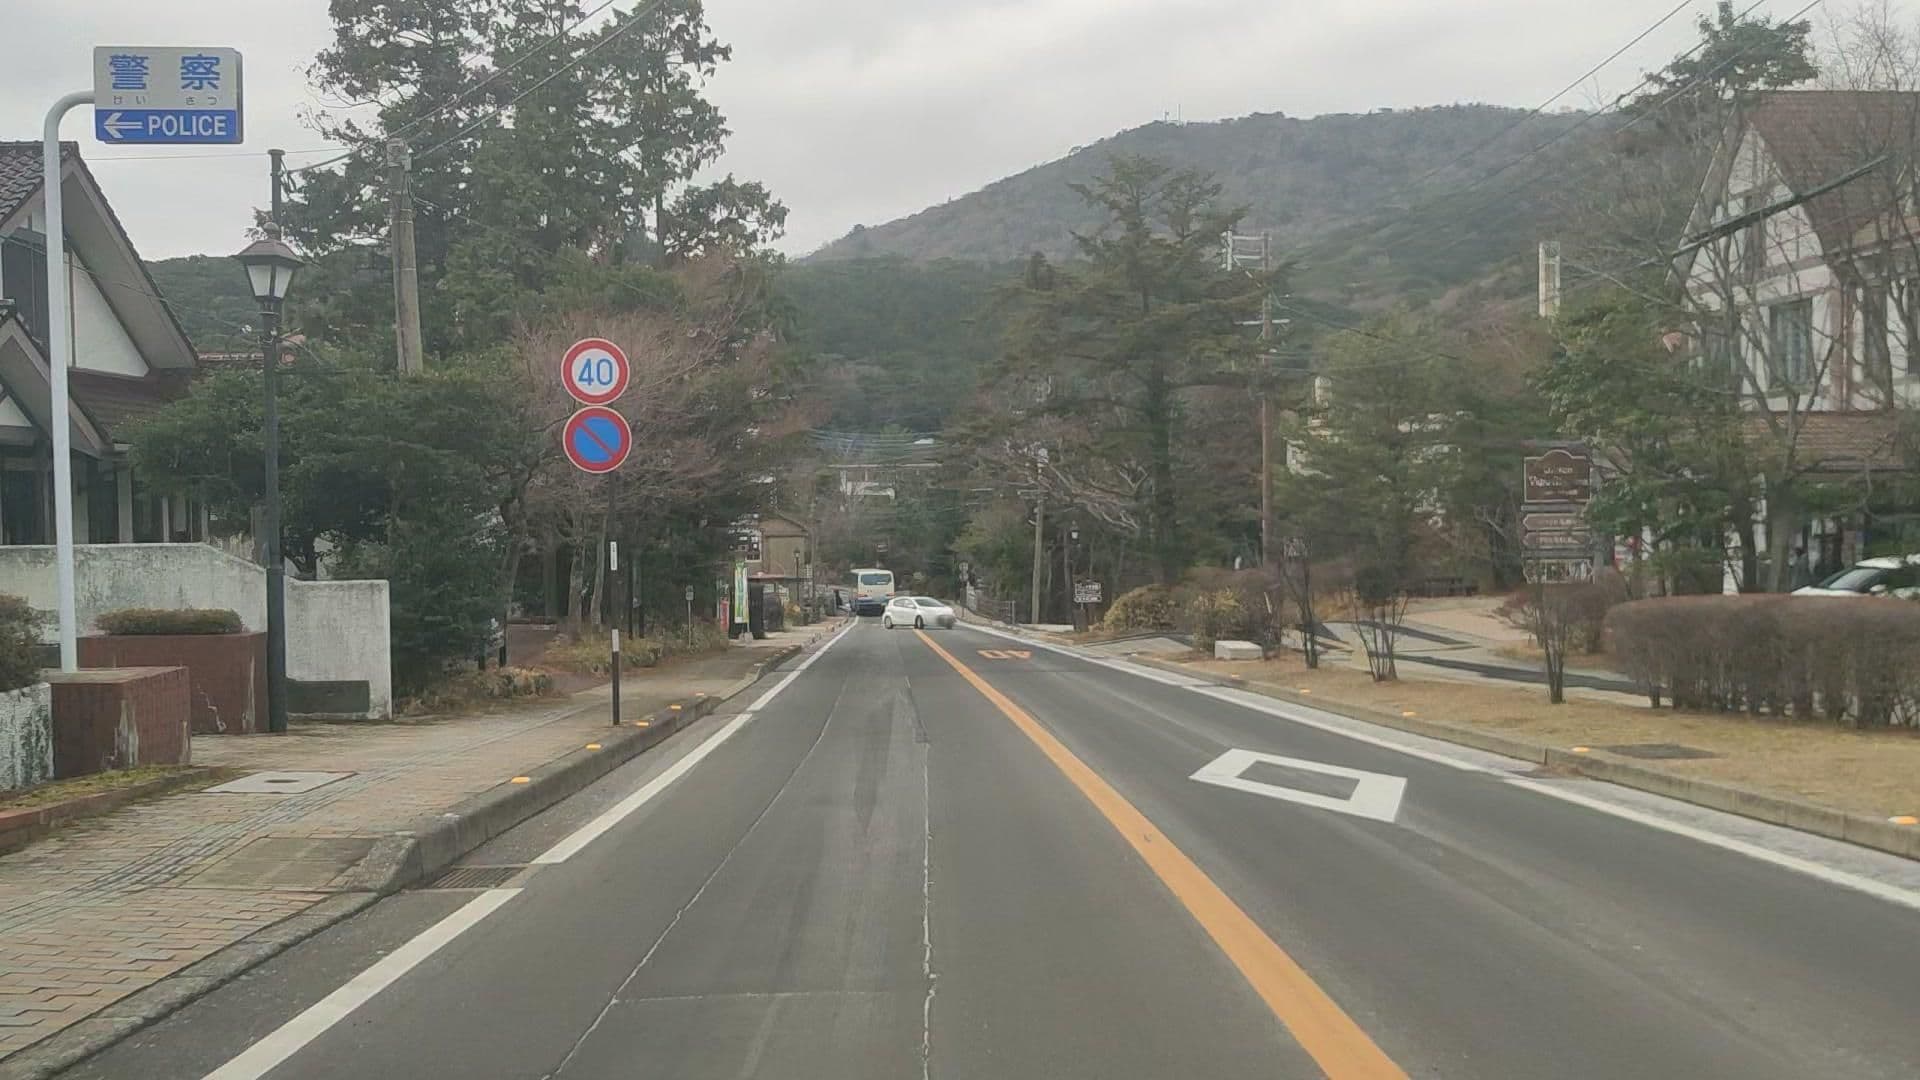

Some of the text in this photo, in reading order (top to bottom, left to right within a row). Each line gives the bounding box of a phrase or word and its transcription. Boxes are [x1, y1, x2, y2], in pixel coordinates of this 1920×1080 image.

[109, 54, 221, 90] 警察
[113, 95, 218, 106] けいさつ
[147, 115, 227, 136] POLICE
[578, 357, 613, 386] 40
